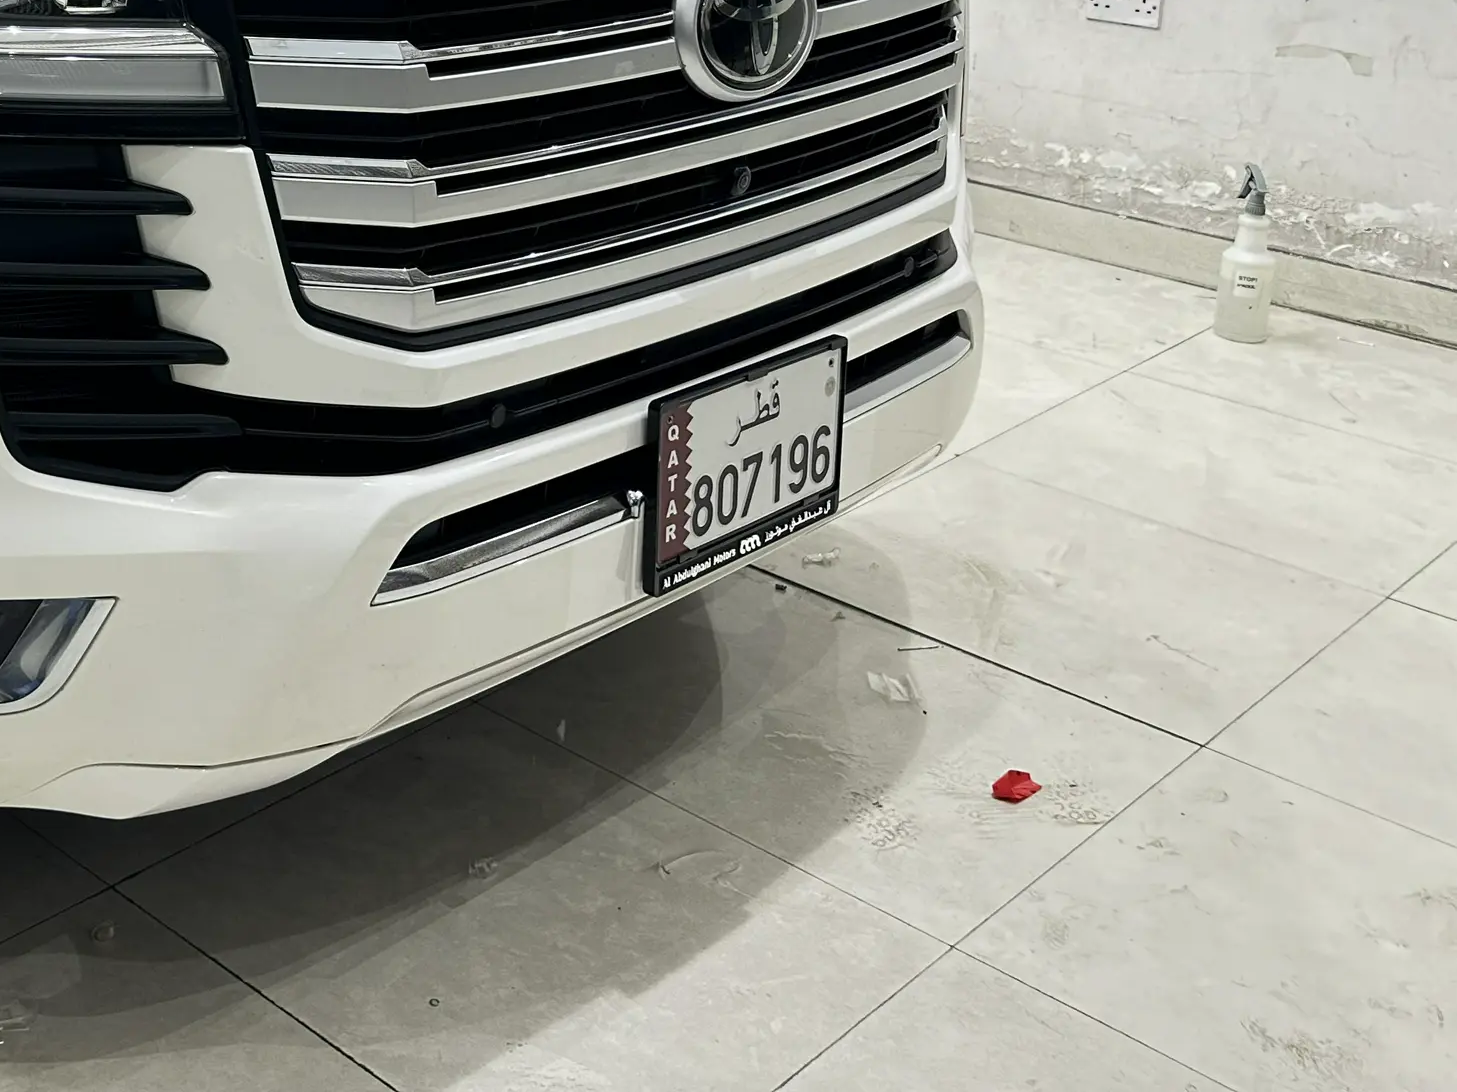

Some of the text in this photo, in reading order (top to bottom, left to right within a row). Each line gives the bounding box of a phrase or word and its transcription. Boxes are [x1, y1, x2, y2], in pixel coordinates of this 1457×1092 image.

[725, 378, 781, 447] قطر
[664, 424, 680, 543] QATAR
[691, 424, 832, 537] 807196
[662, 548, 737, 590] Al Abdulghani Motors
